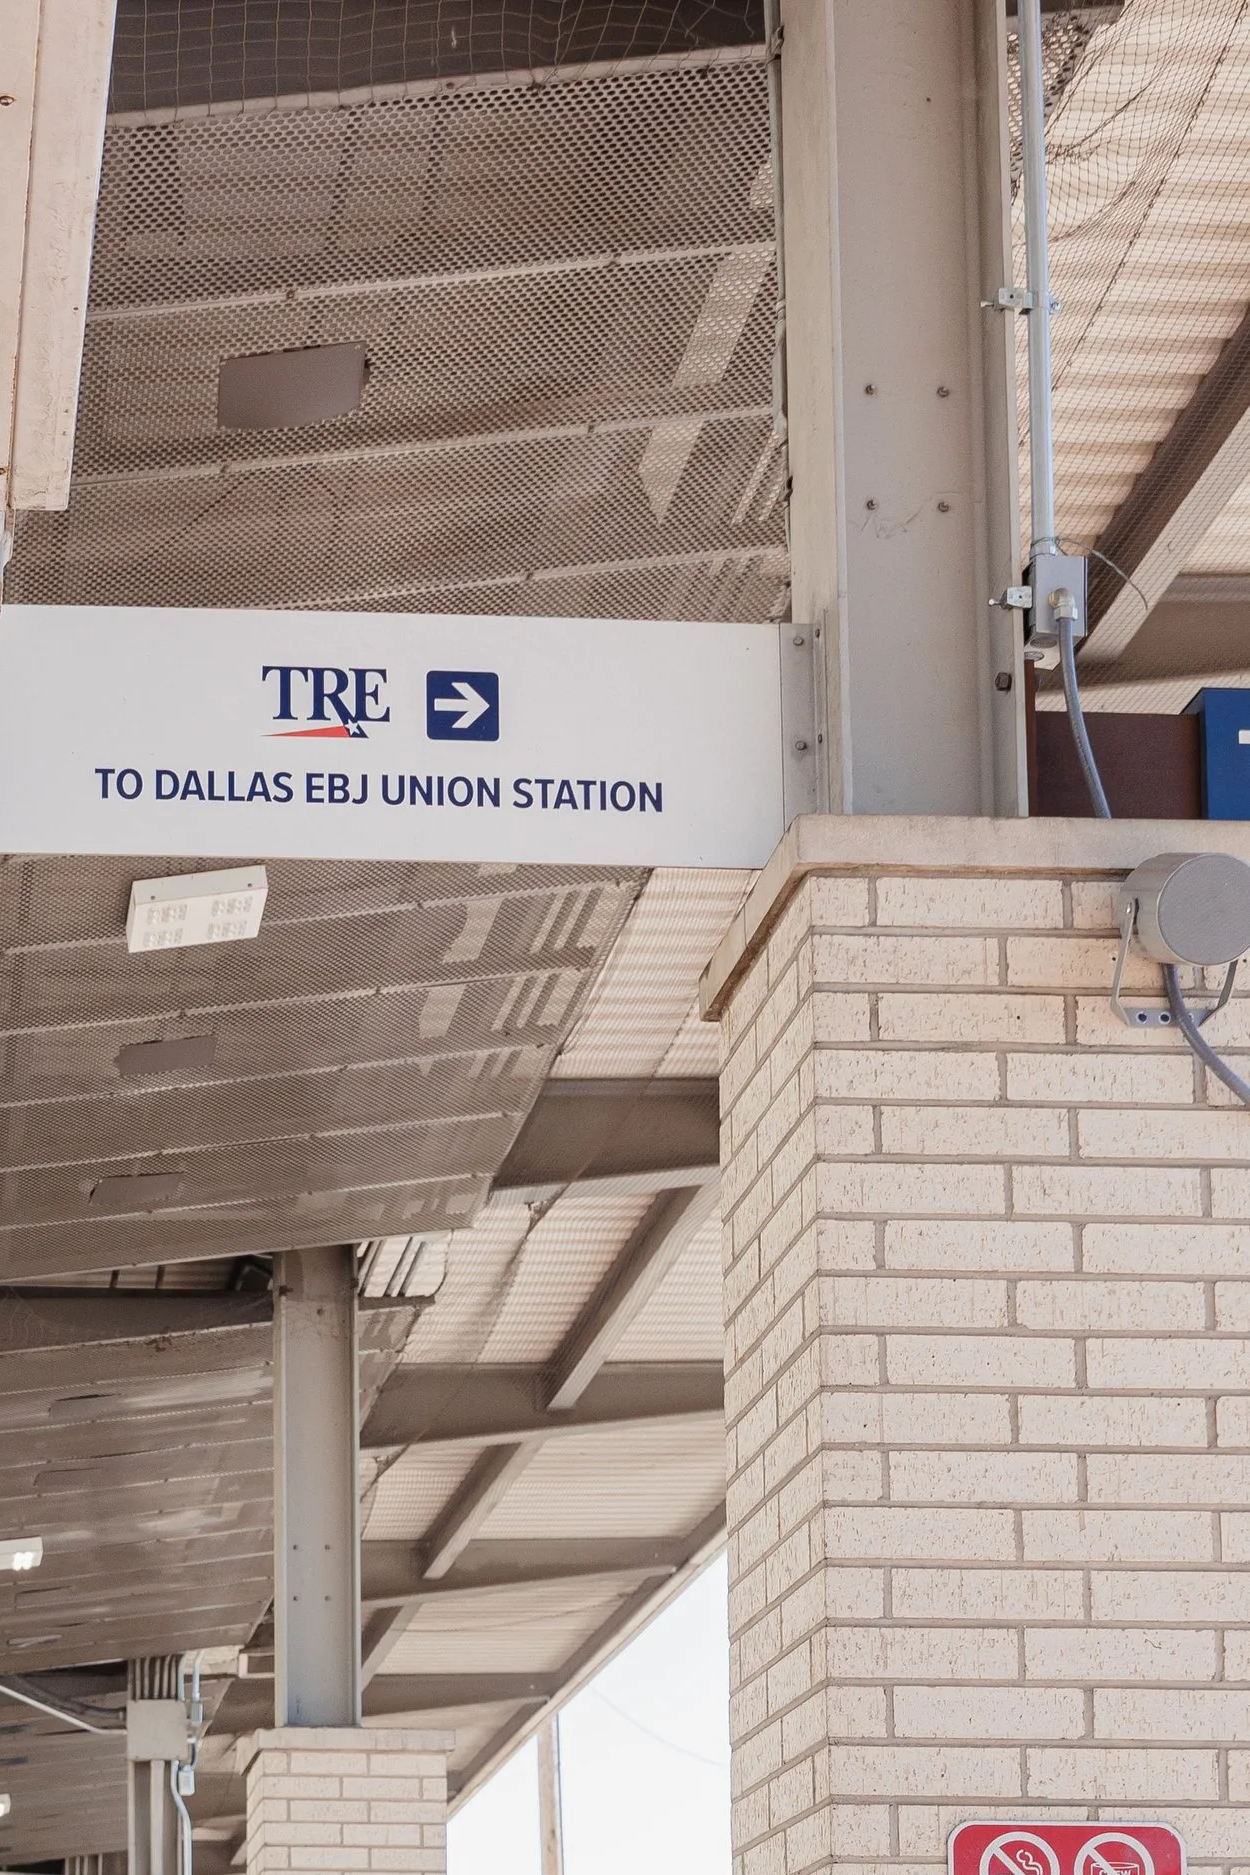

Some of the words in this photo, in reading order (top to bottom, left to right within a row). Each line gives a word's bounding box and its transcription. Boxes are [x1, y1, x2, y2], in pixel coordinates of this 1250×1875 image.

[262, 666, 390, 738] TRE
[95, 769, 142, 799] TO
[156, 770, 293, 802] DALLAS
[306, 773, 367, 804] EBJ
[382, 775, 500, 807] UNION
[513, 778, 662, 812] STATION
